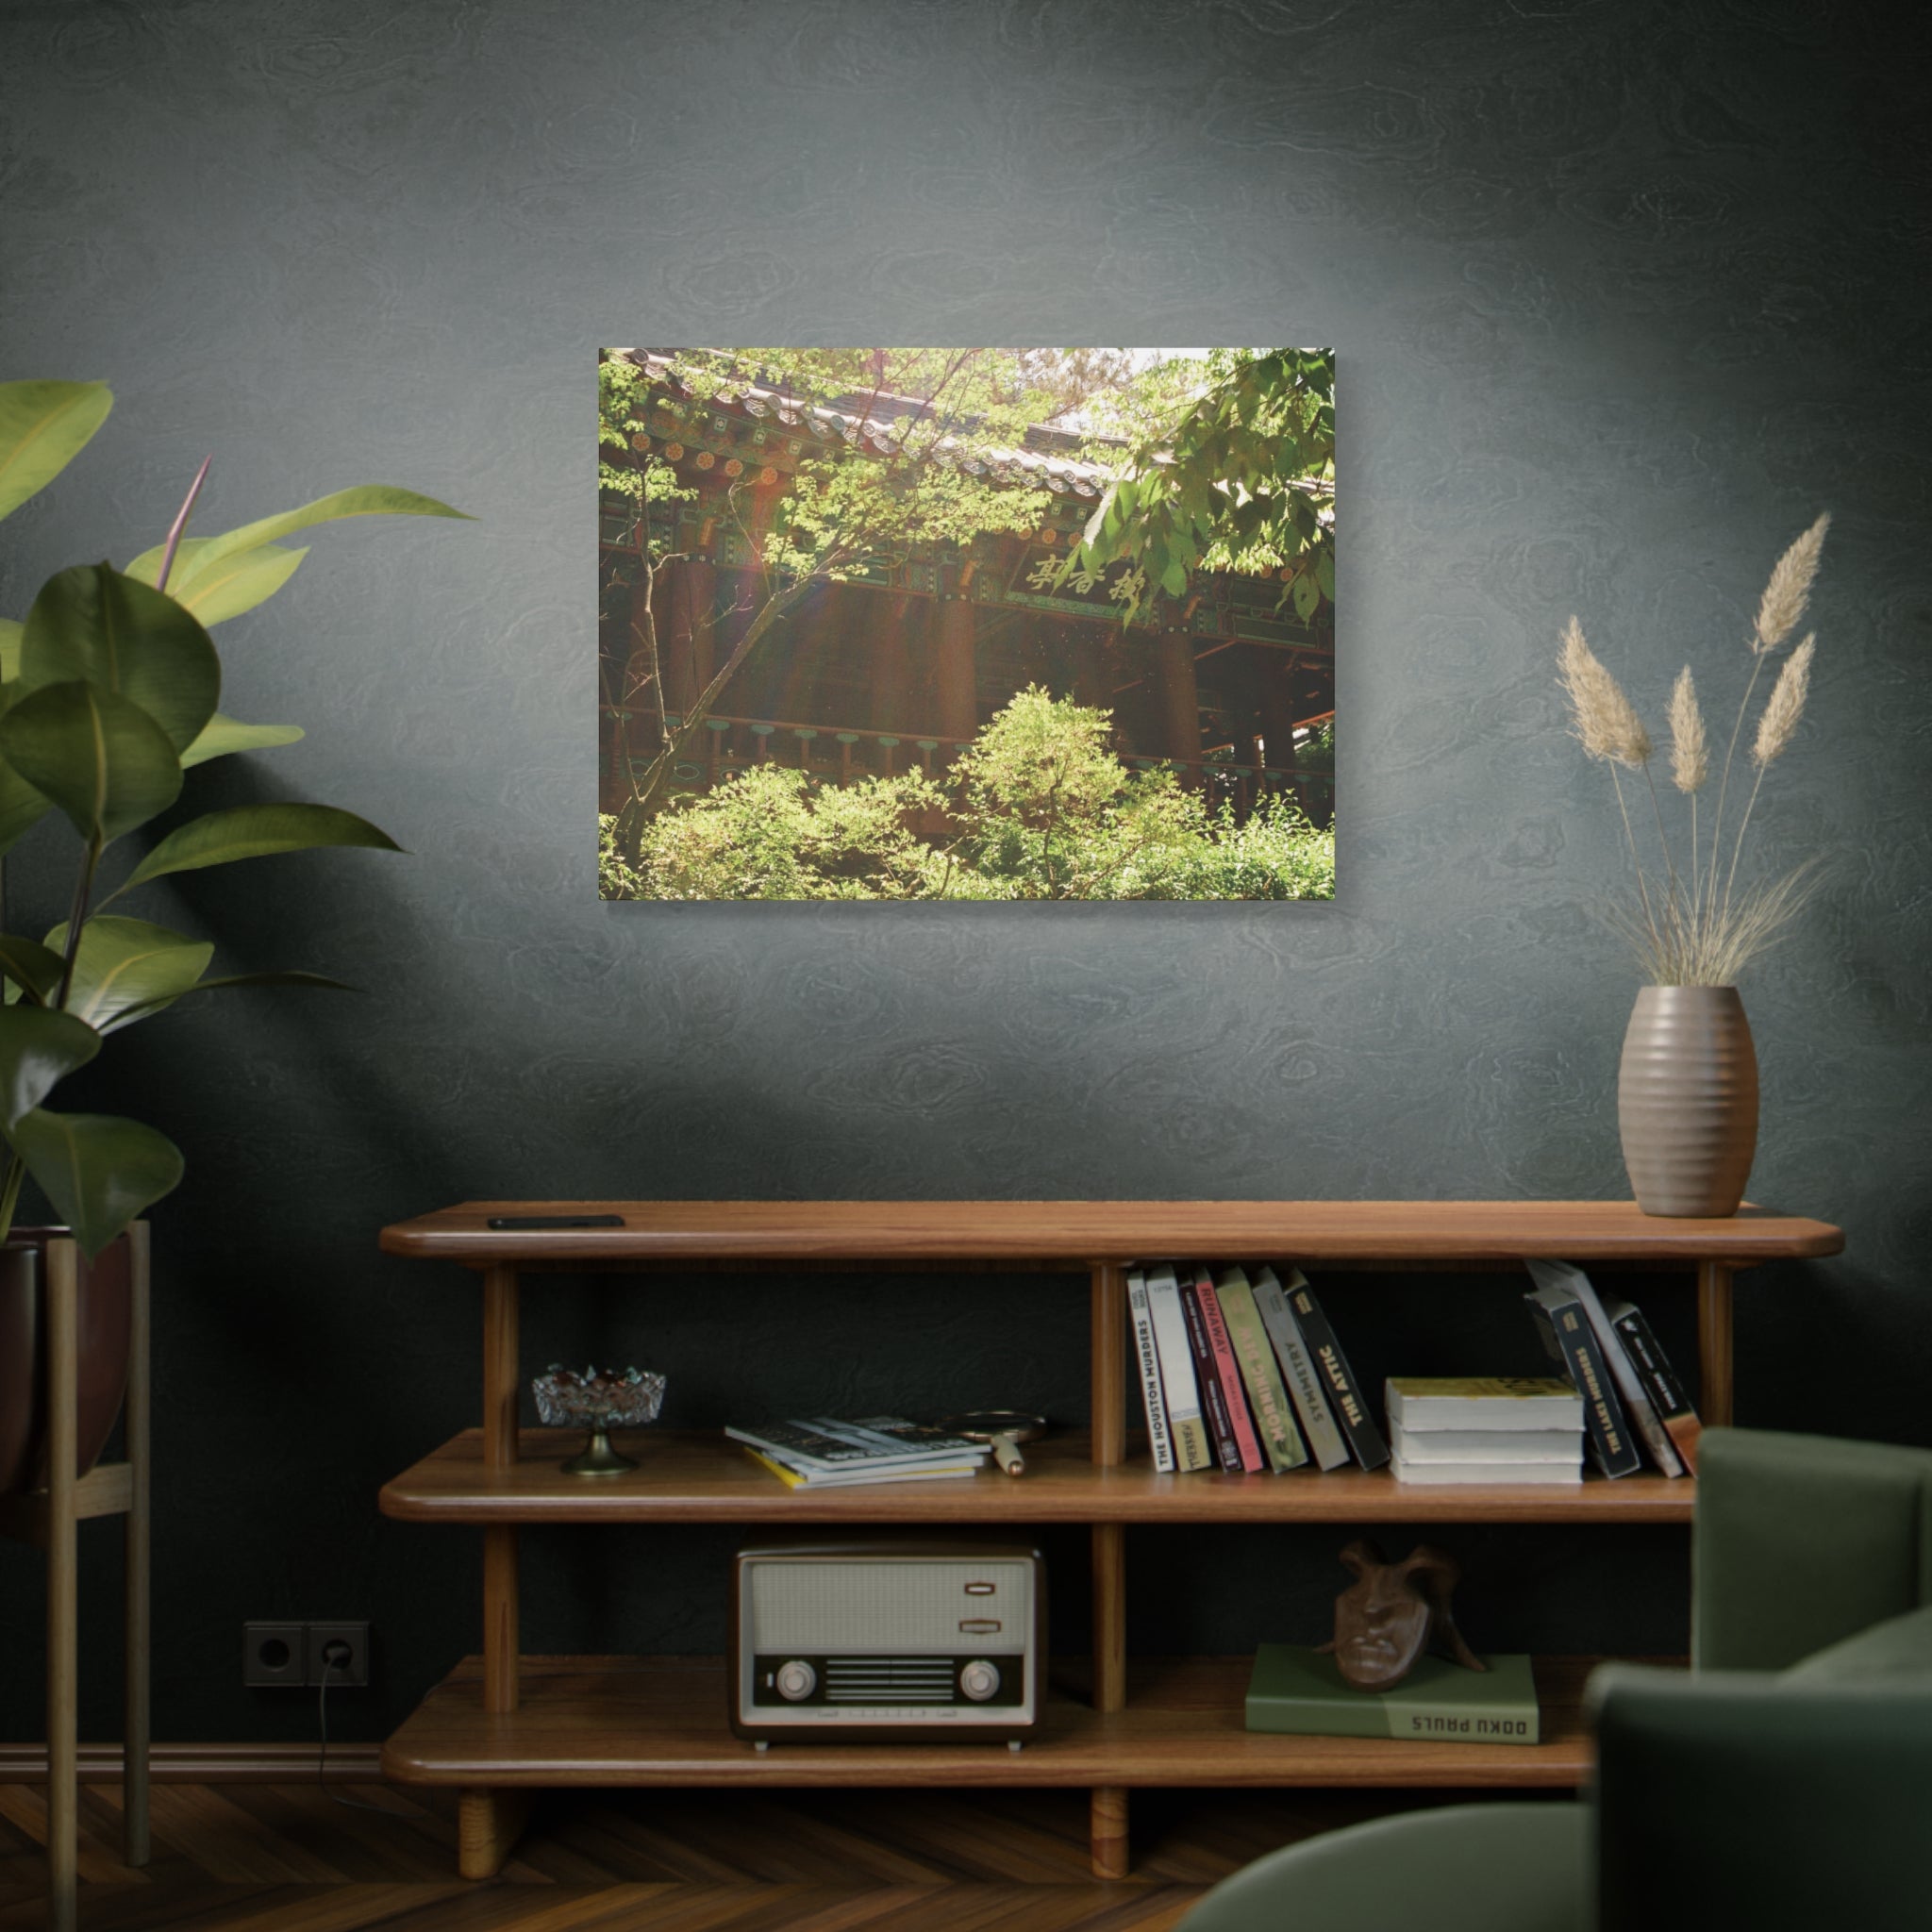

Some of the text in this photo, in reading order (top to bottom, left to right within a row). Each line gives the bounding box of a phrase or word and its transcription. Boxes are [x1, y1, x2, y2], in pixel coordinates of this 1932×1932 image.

[1138, 1319, 1154, 1377] MURDERS
[1201, 1284, 1228, 1355] RUNAWAY
[1251, 1364, 1286, 1441] MORNING
[1285, 1342, 1324, 1423] SYMMETRY
[1319, 1344, 1363, 1427] THE ATTIC
[1575, 1346, 1603, 1401] MURDERS
[1147, 1381, 1164, 1441] HOUSTON
[1156, 1442, 1169, 1467] THE
[1606, 1431, 1622, 1456] THE
[1412, 1716, 1527, 1736] DOKU PAULS
